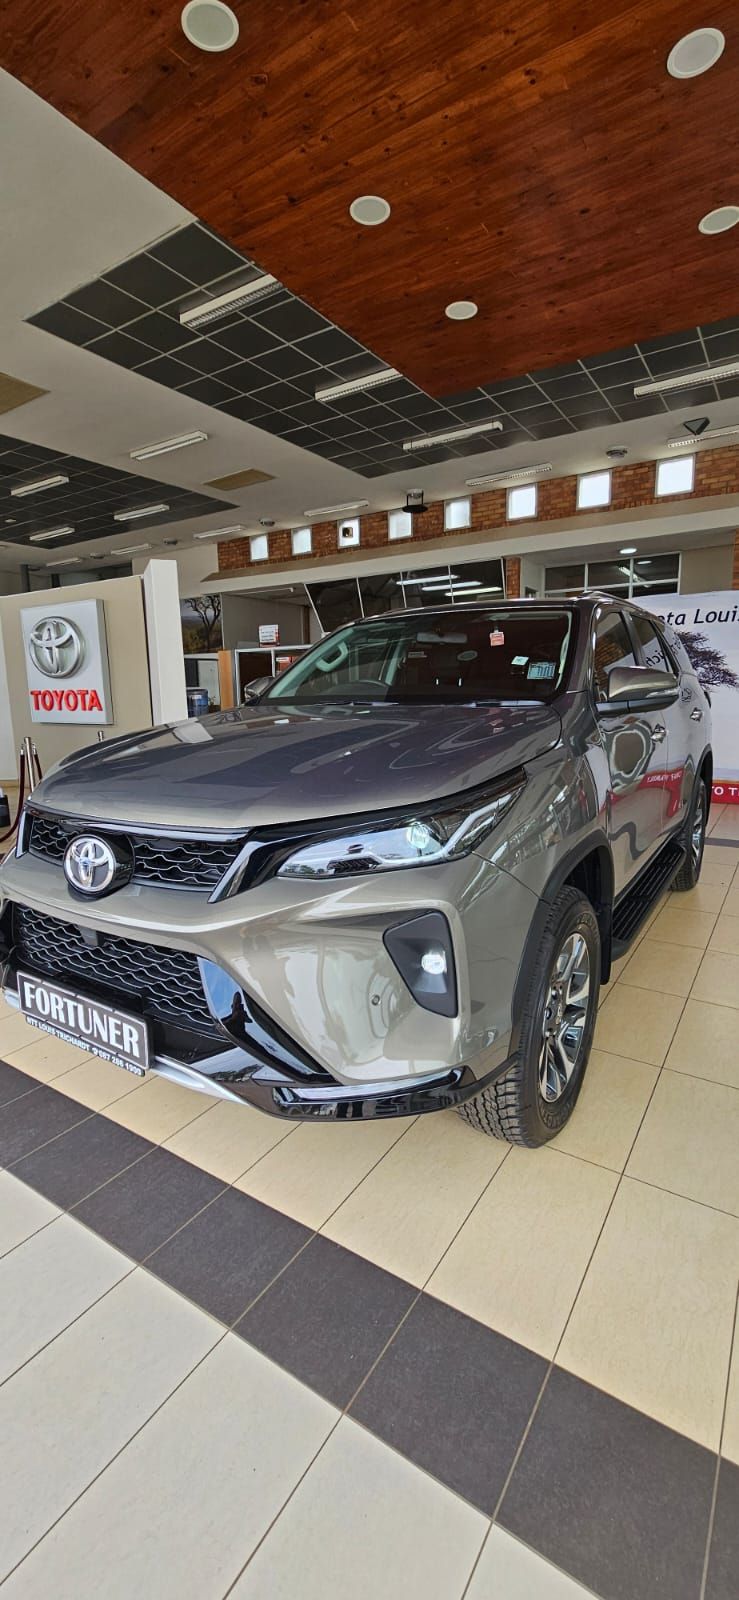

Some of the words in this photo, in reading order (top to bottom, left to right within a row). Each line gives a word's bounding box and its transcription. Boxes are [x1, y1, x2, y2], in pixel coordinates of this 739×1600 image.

[693, 605, 739, 625] Loui
[30, 690, 103, 711] TOYOTA
[23, 981, 140, 1058] FORTUNER
[39, 1021, 56, 1035] LOUIS
